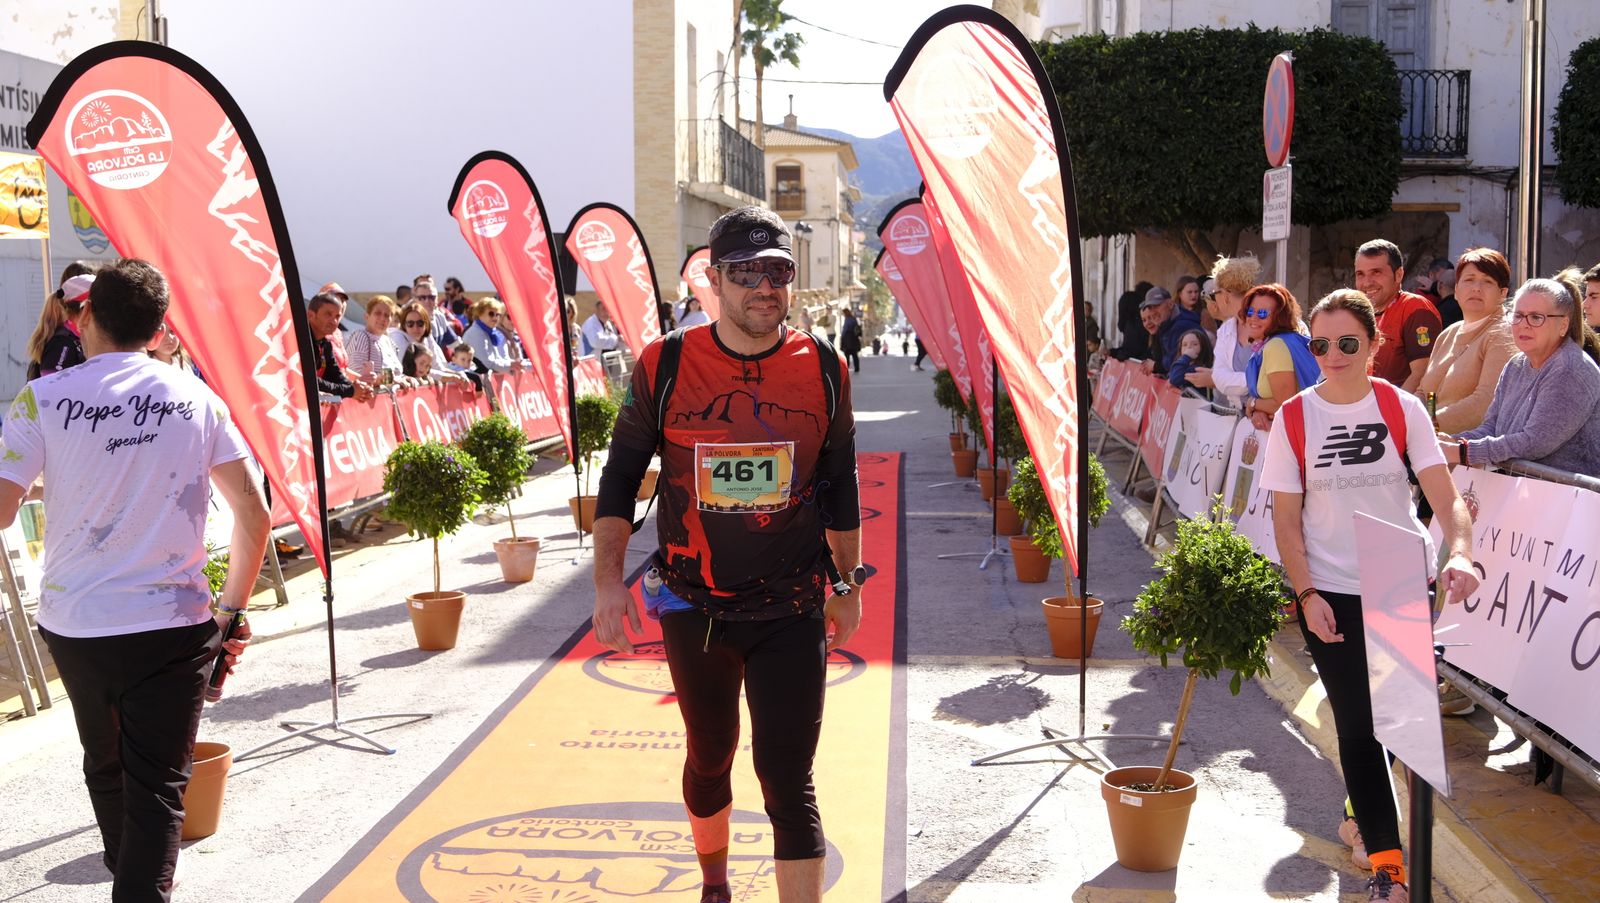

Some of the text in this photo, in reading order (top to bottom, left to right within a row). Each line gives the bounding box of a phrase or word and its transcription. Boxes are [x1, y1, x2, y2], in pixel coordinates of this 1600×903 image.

[56, 394, 198, 433] Pepe Yepes
[105, 429, 158, 455] speaker
[712, 460, 774, 482] 461
